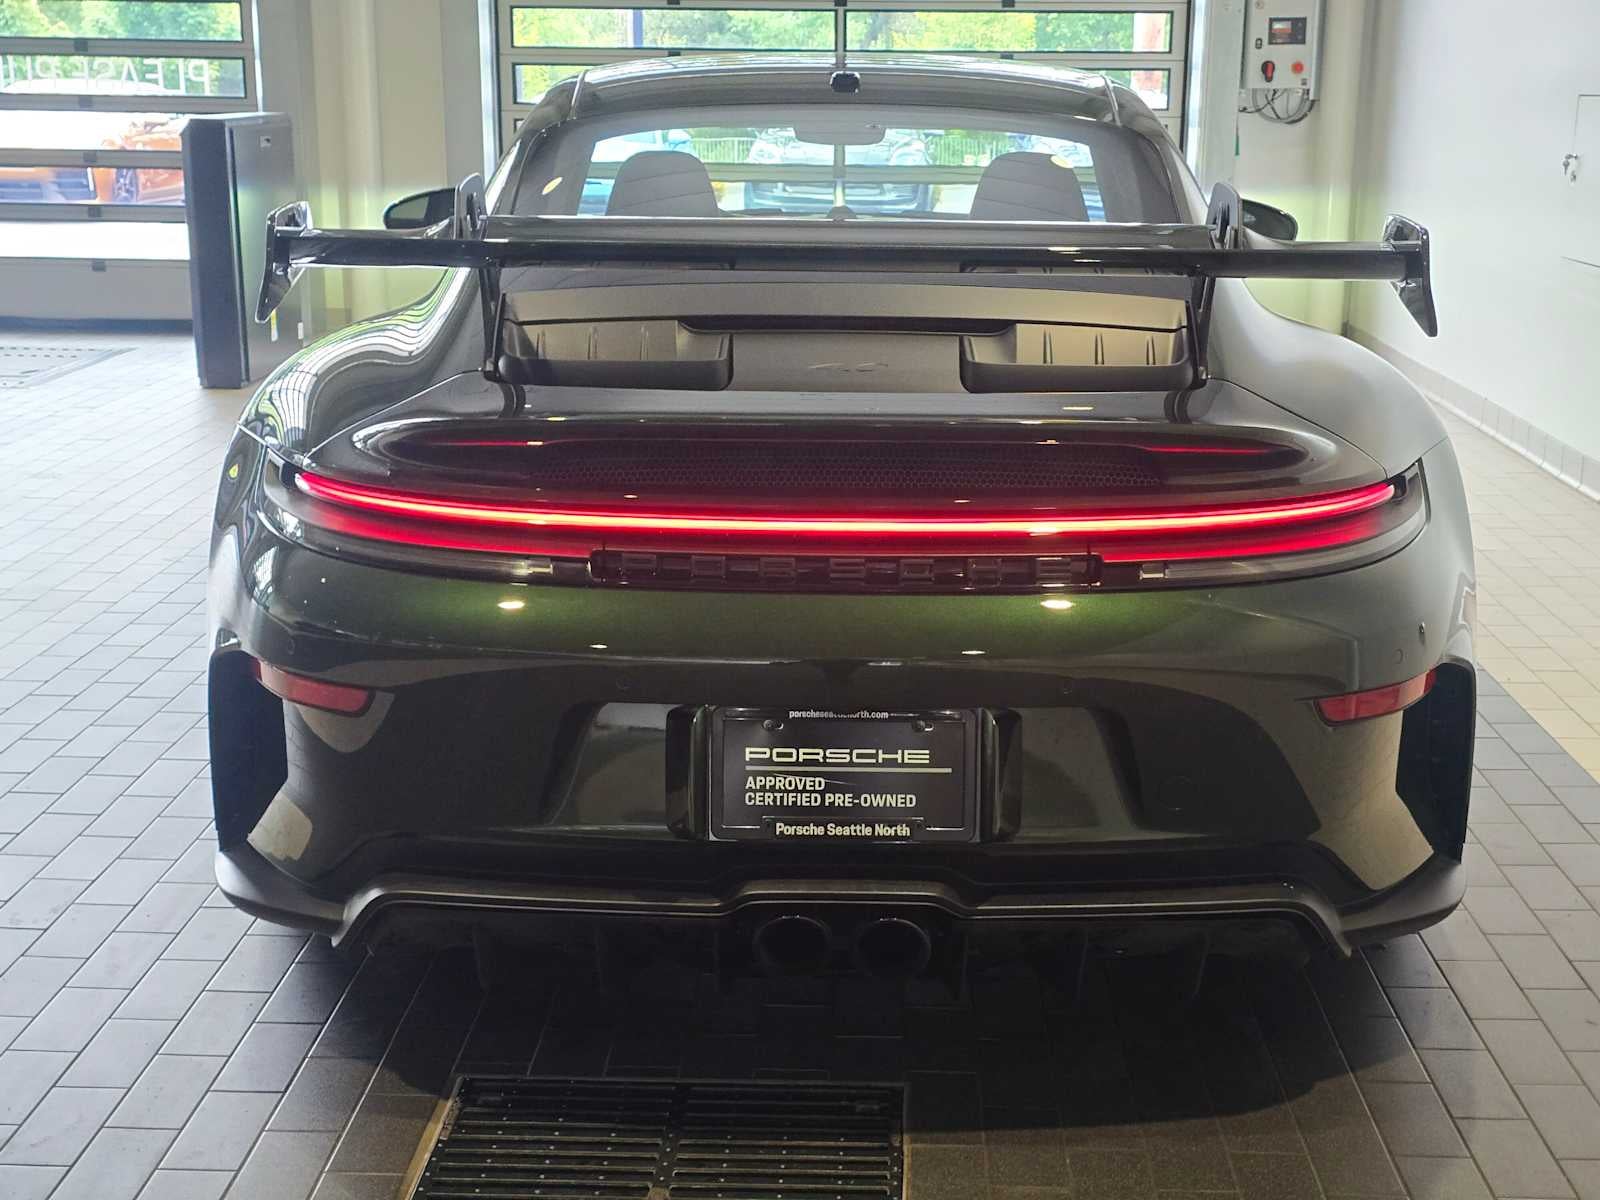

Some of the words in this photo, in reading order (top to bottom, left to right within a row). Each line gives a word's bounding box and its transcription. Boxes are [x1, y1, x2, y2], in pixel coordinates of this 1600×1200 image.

[745, 747, 930, 764] PORSCHE
[745, 775, 826, 791] APPROVED
[745, 792, 821, 807] CERTIFIED
[824, 793, 917, 808] PRE-OWNED
[775, 822, 825, 836] Porsche
[826, 823, 873, 837] Seattle
[874, 823, 911, 837] North
